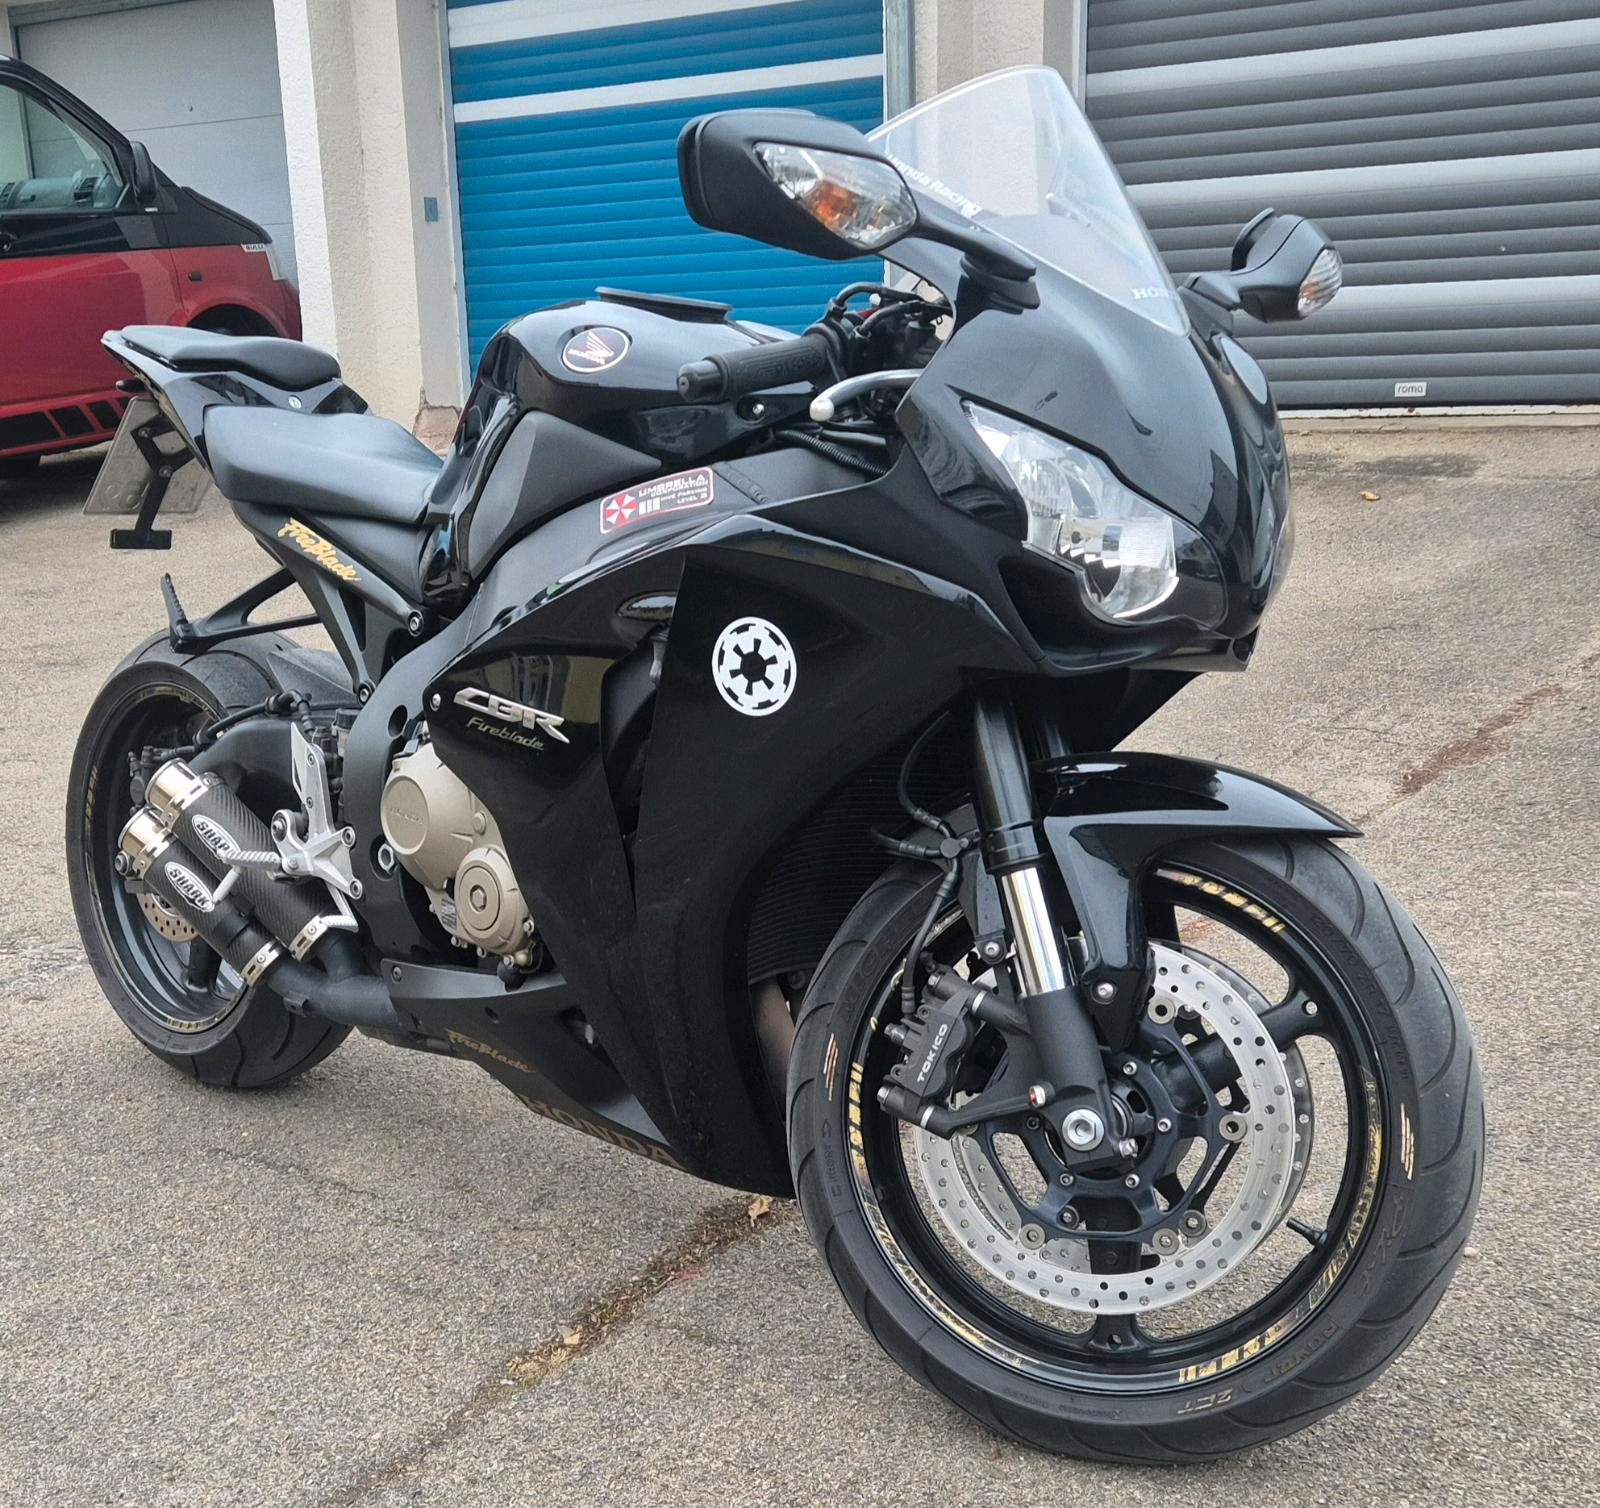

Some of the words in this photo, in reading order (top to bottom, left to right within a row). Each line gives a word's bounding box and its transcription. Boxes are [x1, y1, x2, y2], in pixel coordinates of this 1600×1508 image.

[929, 180, 982, 218] Racing
[1397, 384, 1424, 394] roma
[638, 474, 706, 497] UMBRELLA
[453, 686, 570, 744] CBR
[466, 716, 545, 751] Fireblade
[197, 820, 232, 852] SHAR
[169, 868, 210, 907] SHARK
[917, 1023, 948, 1082] TOKICO
